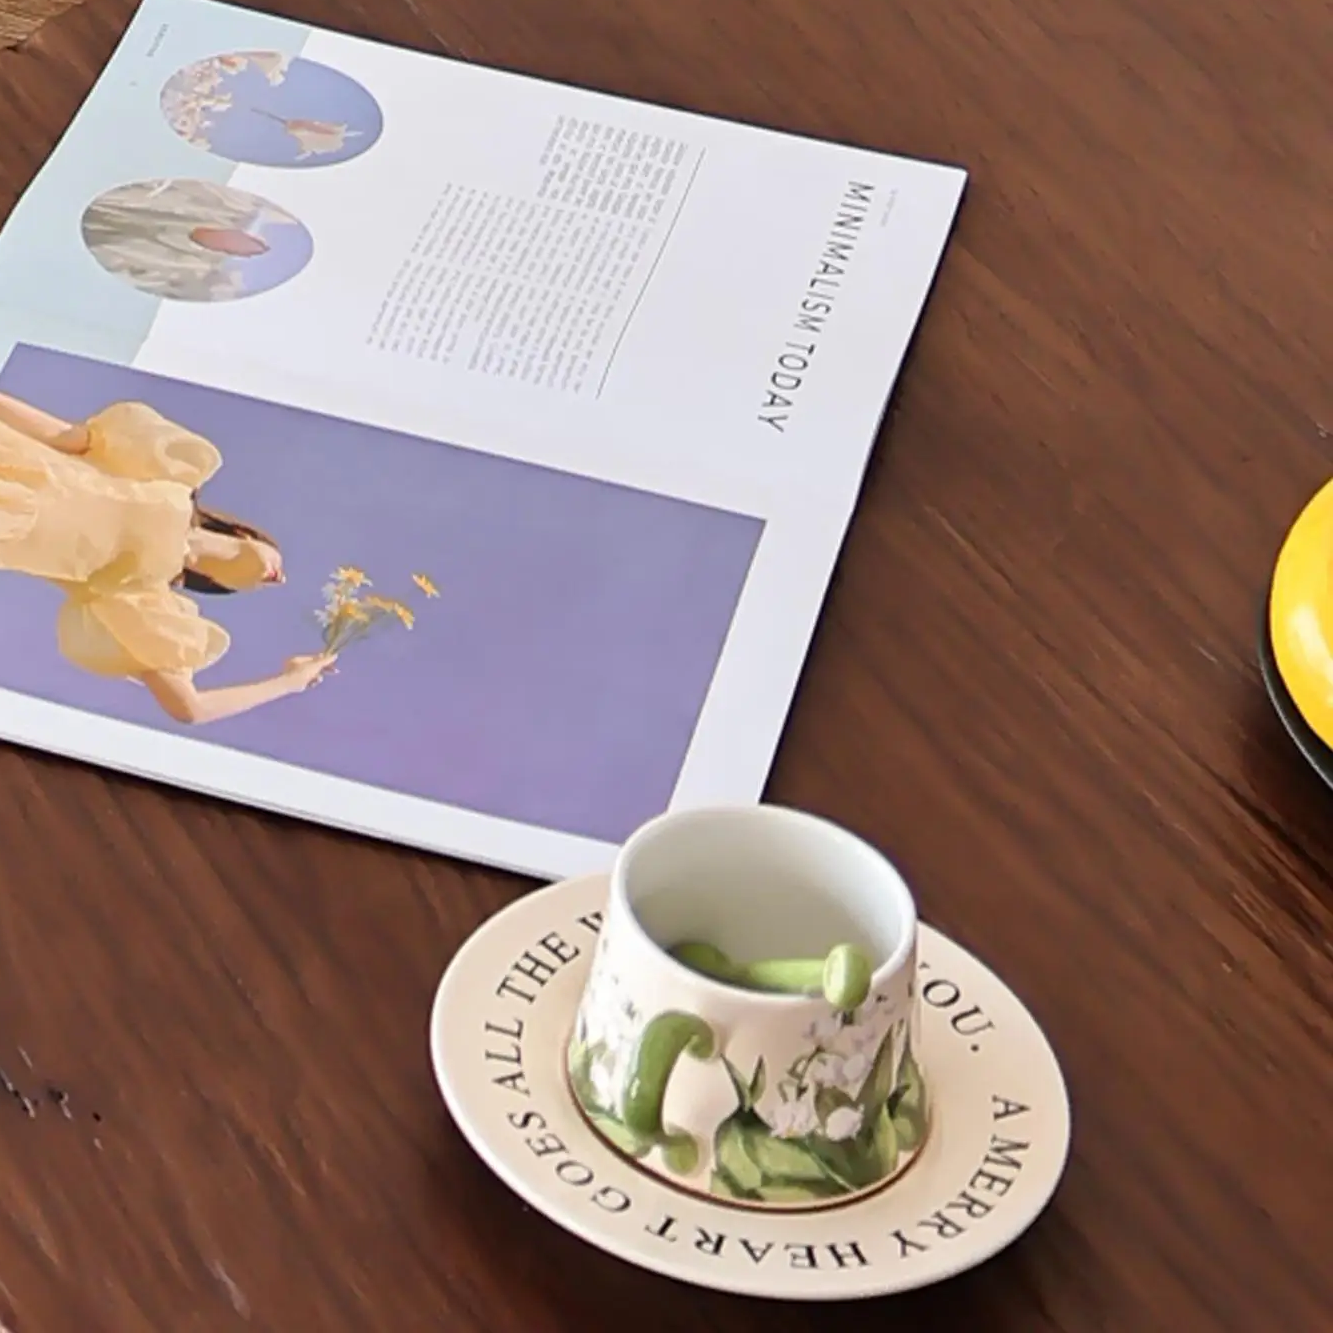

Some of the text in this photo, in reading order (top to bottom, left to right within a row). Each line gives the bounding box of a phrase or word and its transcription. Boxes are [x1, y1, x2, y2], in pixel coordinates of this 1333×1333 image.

[757, 180, 875, 434] MINIMALISM TODAY
[484, 930, 1031, 1272] A MERRY HEART GOES ALL THE
[917, 961, 997, 1053] OU.
